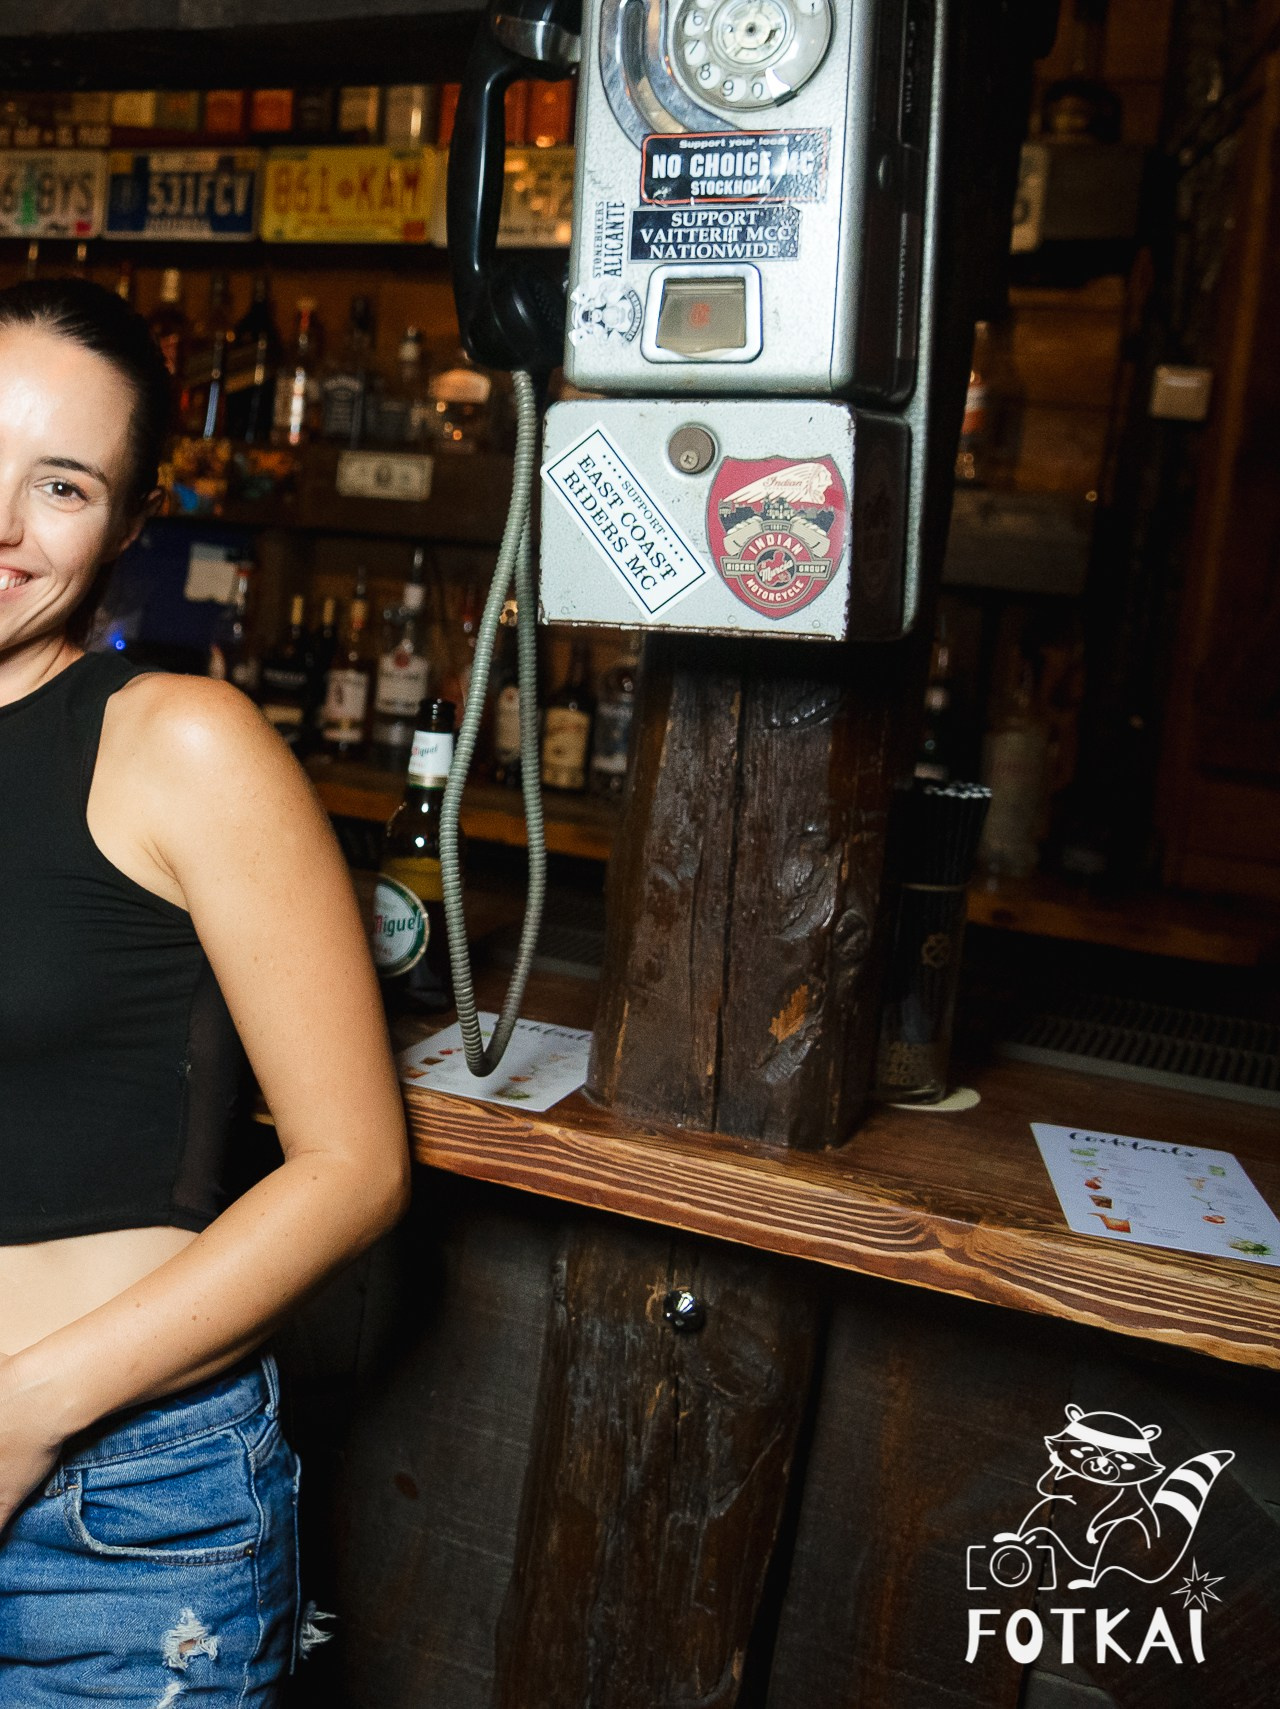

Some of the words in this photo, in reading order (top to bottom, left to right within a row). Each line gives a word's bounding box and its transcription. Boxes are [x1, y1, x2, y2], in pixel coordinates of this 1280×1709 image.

[678, 138, 726, 150] Support
[728, 136, 755, 148] your
[651, 153, 682, 179] NO
[690, 179, 772, 197] STOCKHOLM
[670, 210, 759, 227] SUPPORT
[593, 201, 605, 278] STONEBIKERS
[604, 200, 625, 278] ALICANTE
[649, 243, 780, 260] NATIONWIDE
[762, 475, 804, 488] Indian
[578, 454, 623, 510] EAST
[620, 512, 677, 580] COAST
[621, 480, 666, 536] SUPPORT
[562, 470, 628, 553] RIDERS
[624, 554, 657, 591] MC
[748, 533, 804, 555] INDIAN
[726, 563, 756, 571] RIDERS
[759, 559, 794, 582] Murcia
[798, 564, 826, 573] GROUP
[746, 578, 805, 602] MOTORCYCLE
